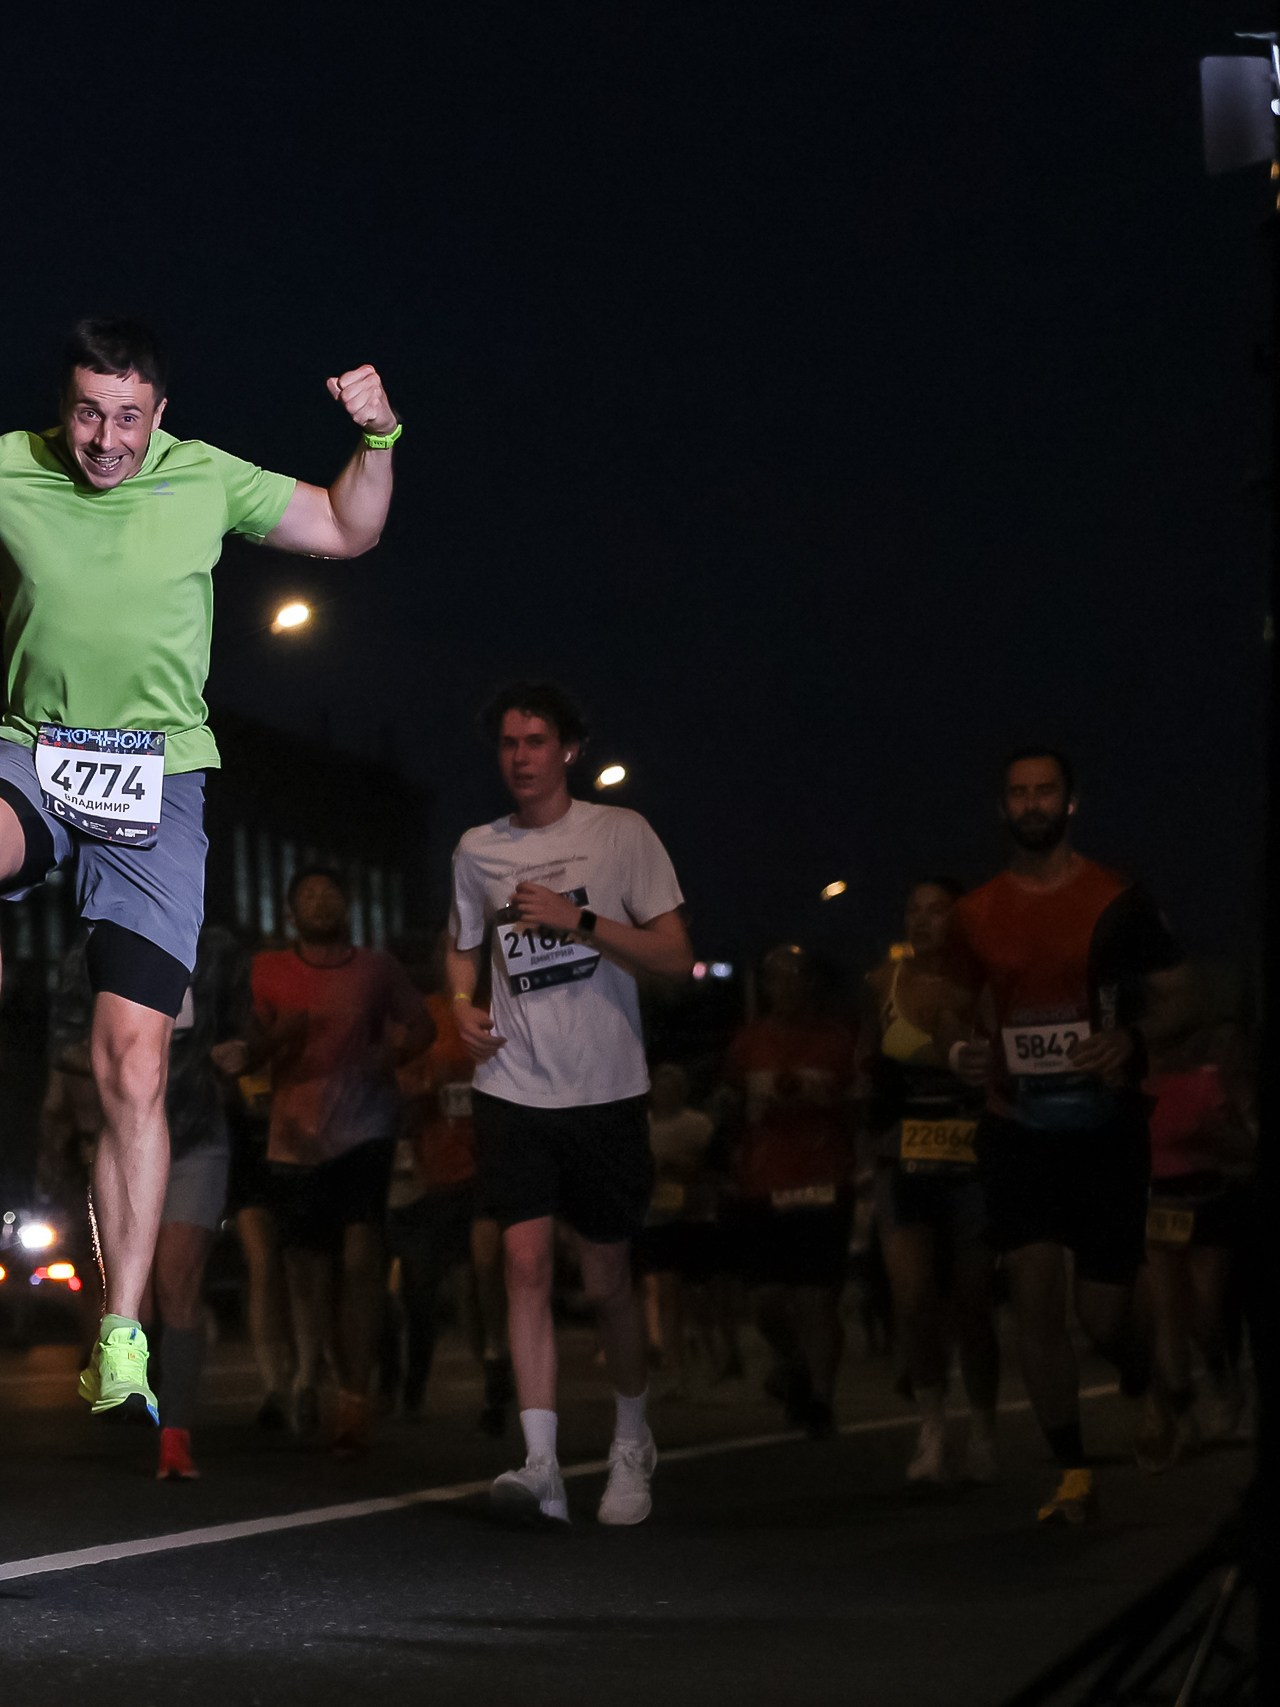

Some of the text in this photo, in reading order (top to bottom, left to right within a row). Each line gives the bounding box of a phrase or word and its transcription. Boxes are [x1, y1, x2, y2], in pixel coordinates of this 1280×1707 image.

[54, 728, 153, 750] НОЧНОЙ
[51, 759, 146, 801] 4774
[64, 793, 131, 813] ВЛАДИМИР
[520, 976, 531, 992] D
